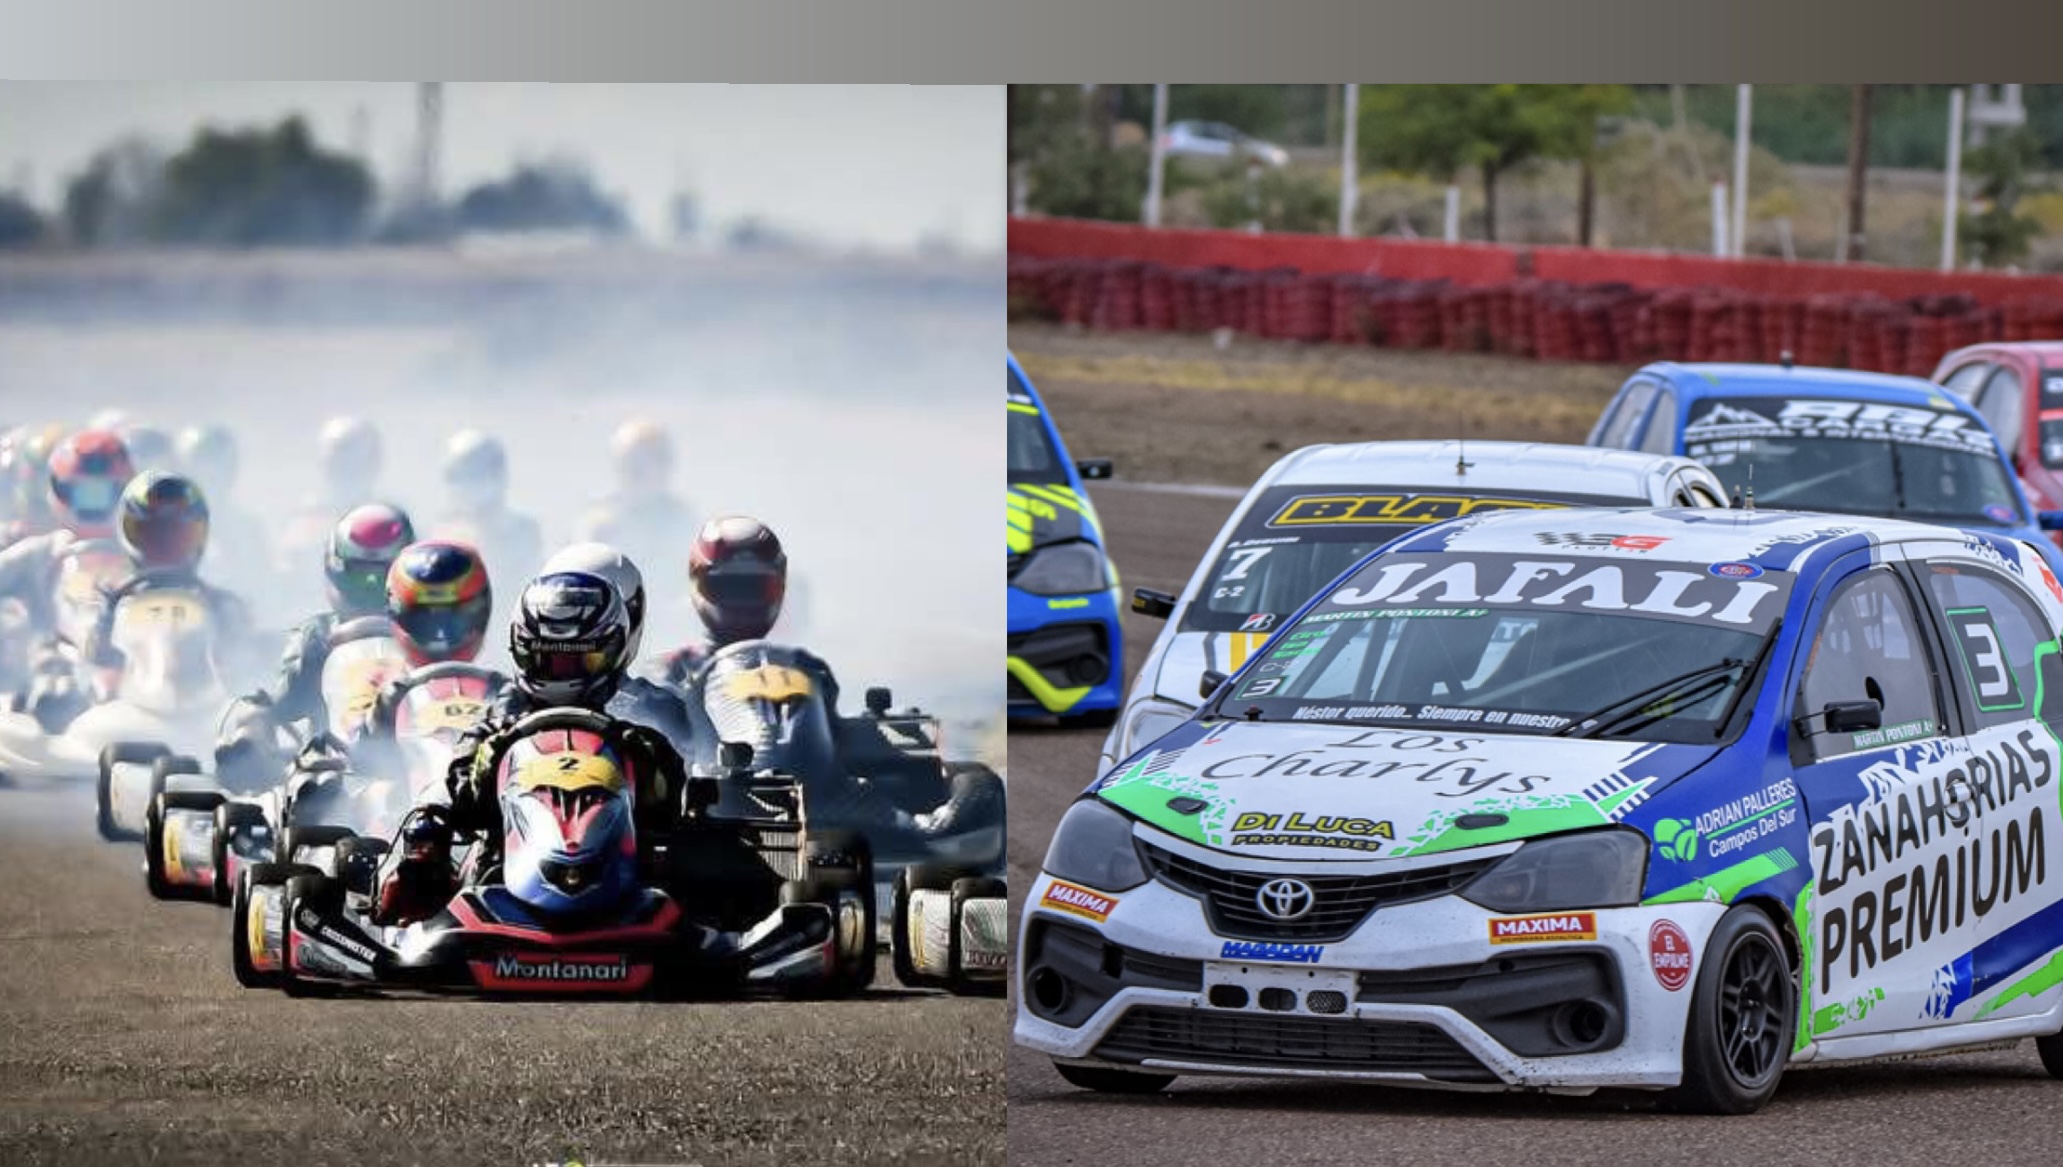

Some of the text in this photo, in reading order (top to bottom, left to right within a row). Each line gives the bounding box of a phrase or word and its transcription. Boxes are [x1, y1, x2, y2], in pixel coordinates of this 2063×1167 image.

[1221, 546, 1273, 581] 7
[1332, 561, 1779, 625] JAFALI
[1964, 623, 2009, 697] 3
[1240, 678, 1281, 698] 3
[1293, 705, 1344, 720] Néstor
[1417, 704, 1484, 722] Siempre
[1483, 711, 1508, 726] en
[1324, 731, 1485, 752] Los
[558, 757, 580, 770] 2
[1201, 750, 1551, 796] Charlys
[1695, 777, 1797, 837] ADRIAN PALLERES
[1813, 728, 2052, 896] ZANAHORIAS
[1232, 834, 1382, 851] PROPIEDADES
[1709, 807, 1797, 858] Campos Del Sur
[1049, 884, 1109, 913] MAXIMA
[1821, 806, 2045, 995] PREMIUM
[1497, 916, 1584, 935] MAXIMA
[1664, 935, 1676, 951] EL
[496, 953, 627, 979] Montanari
